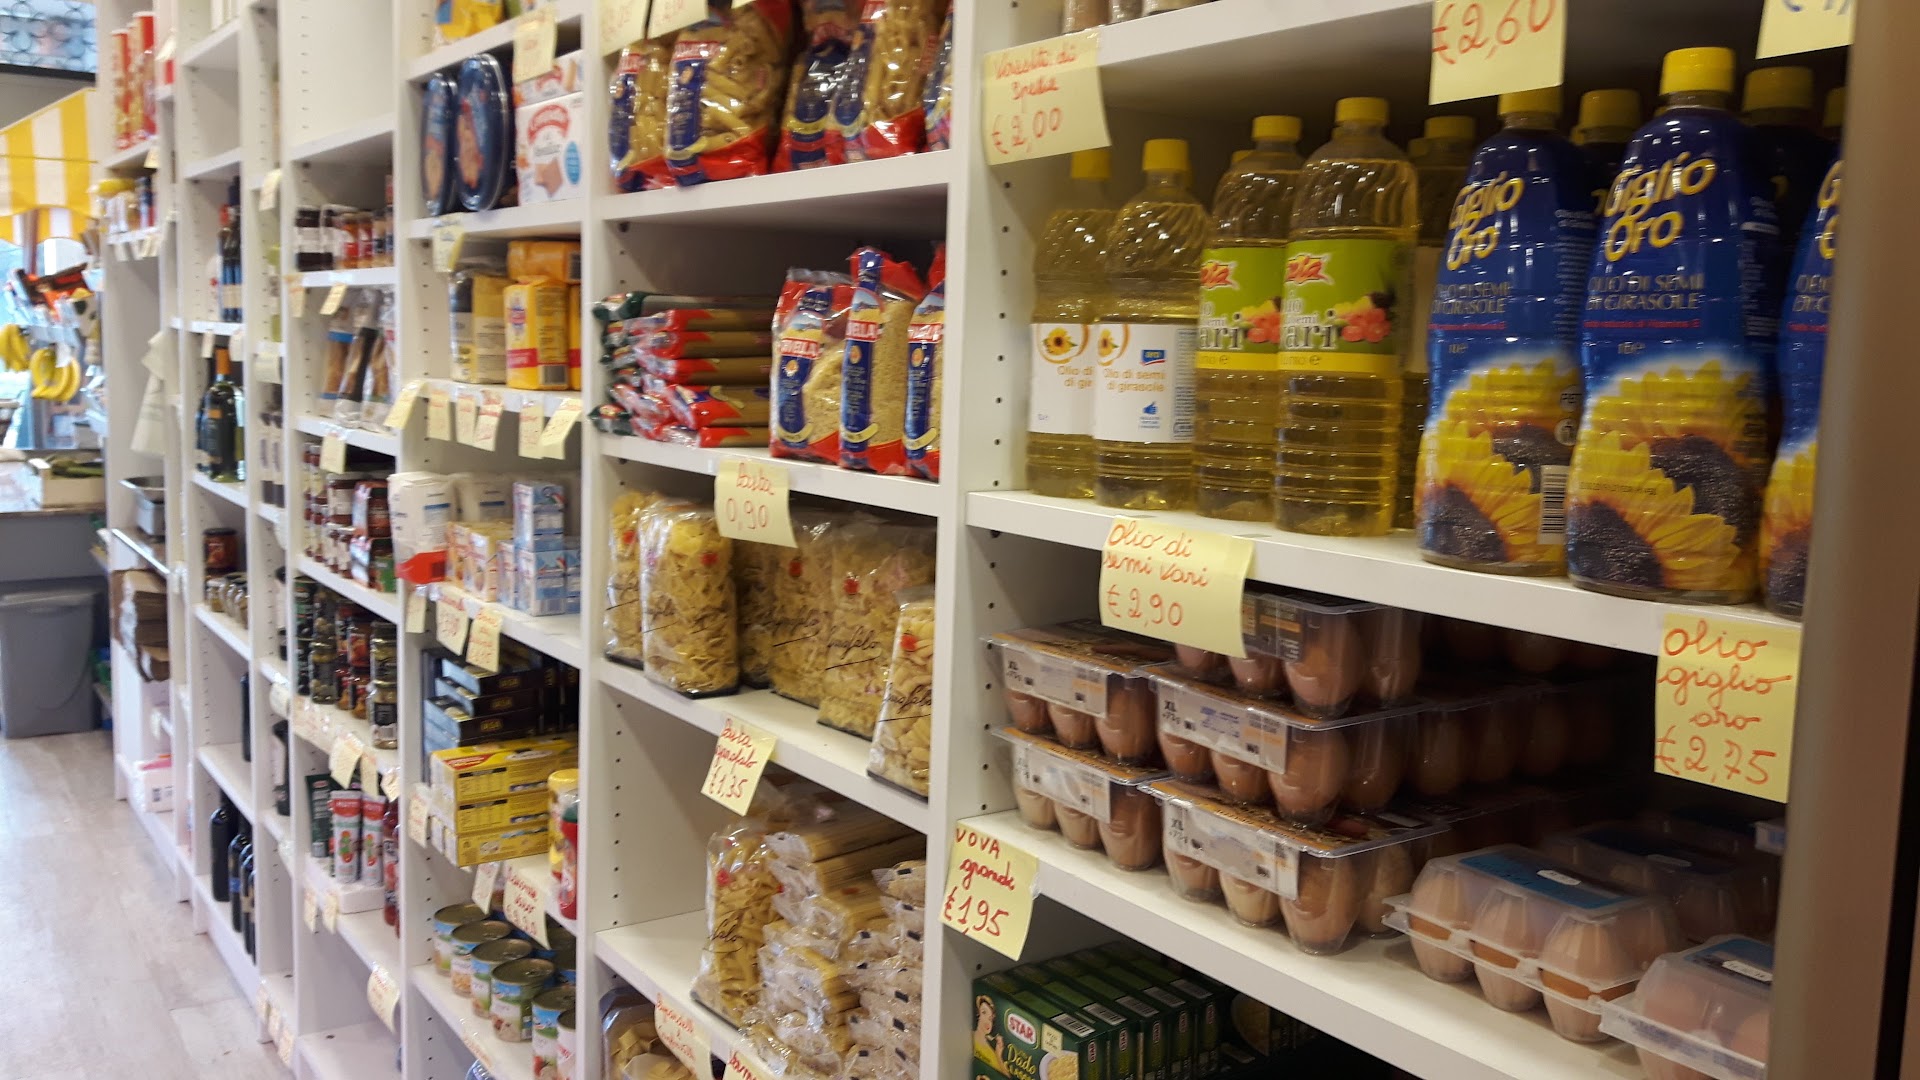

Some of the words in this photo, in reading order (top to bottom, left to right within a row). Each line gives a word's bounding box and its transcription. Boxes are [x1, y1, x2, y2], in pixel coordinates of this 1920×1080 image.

[1449, 171, 1525, 229] Giglio
[1604, 152, 1717, 217] Giglio
[1447, 226, 1500, 271] Oro
[1604, 211, 1684, 262] Oro
[726, 497, 768, 531] 0,90
[1108, 520, 1163, 549] Olio
[1163, 533, 1193, 558] di
[1102, 552, 1153, 575] semi
[1106, 584, 1184, 628] €2,90
[1664, 618, 1768, 661] Olio
[1657, 664, 1792, 711] giglio
[1689, 709, 1761, 731] oro
[1654, 725, 1777, 785] €2,75
[944, 886, 1010, 936] €1,95
[1009, 1015, 1036, 1042] STAR
[1007, 1043, 1037, 1075] Dado
